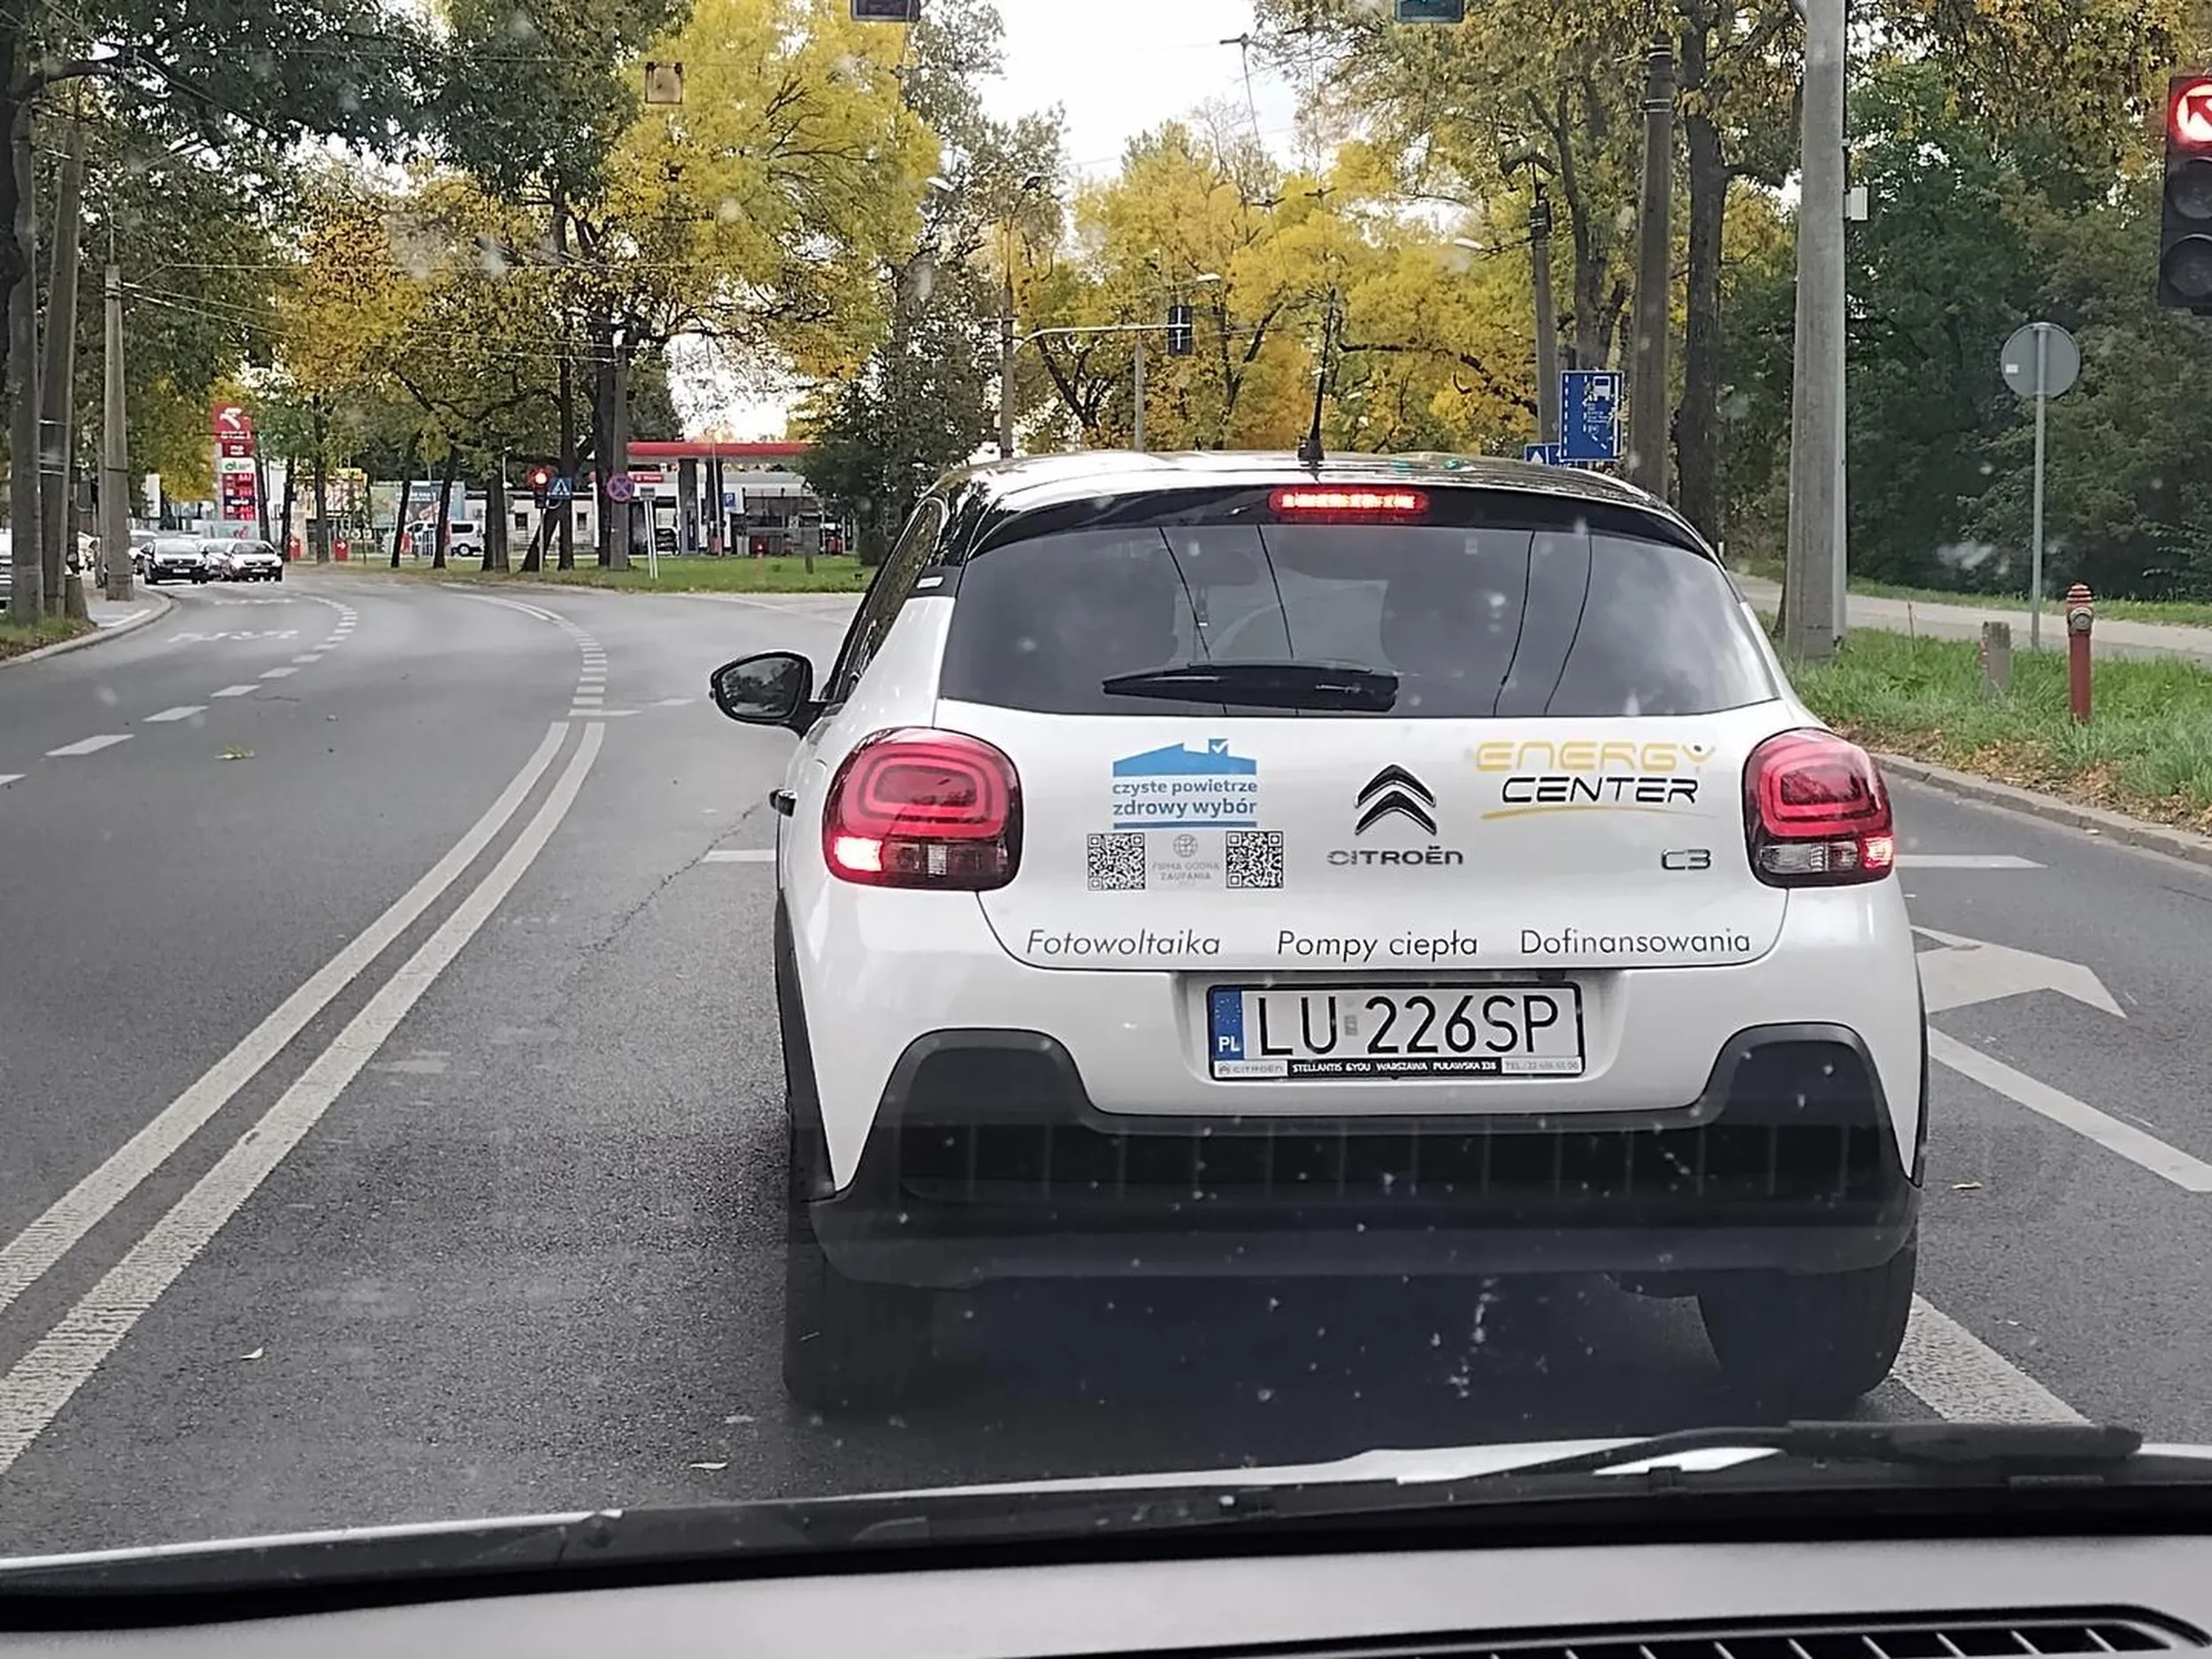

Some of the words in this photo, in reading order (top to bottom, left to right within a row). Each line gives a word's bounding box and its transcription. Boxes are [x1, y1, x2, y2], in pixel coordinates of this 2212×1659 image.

[1476, 741, 1716, 772] ENERGY
[1112, 780, 1167, 796] czyste
[1171, 779, 1257, 795] powietrze
[1502, 776, 1698, 803] CENTER
[1112, 800, 1187, 818] zdrowy
[1193, 798, 1256, 818] wybór
[1661, 849, 1711, 870] C3
[1026, 928, 1220, 955] Fotowoltaika
[1278, 930, 1379, 963] Pompy
[1389, 930, 1478, 962] ciepła
[1521, 927, 1751, 954] Dofinansowania
[1258, 996, 1338, 1056] LU
[1365, 995, 1558, 1054] 226SP
[1218, 1036, 1240, 1052] PL
[1292, 1062, 1342, 1073] STELLANTIS
[1377, 1062, 1428, 1071] WARSZAWA
